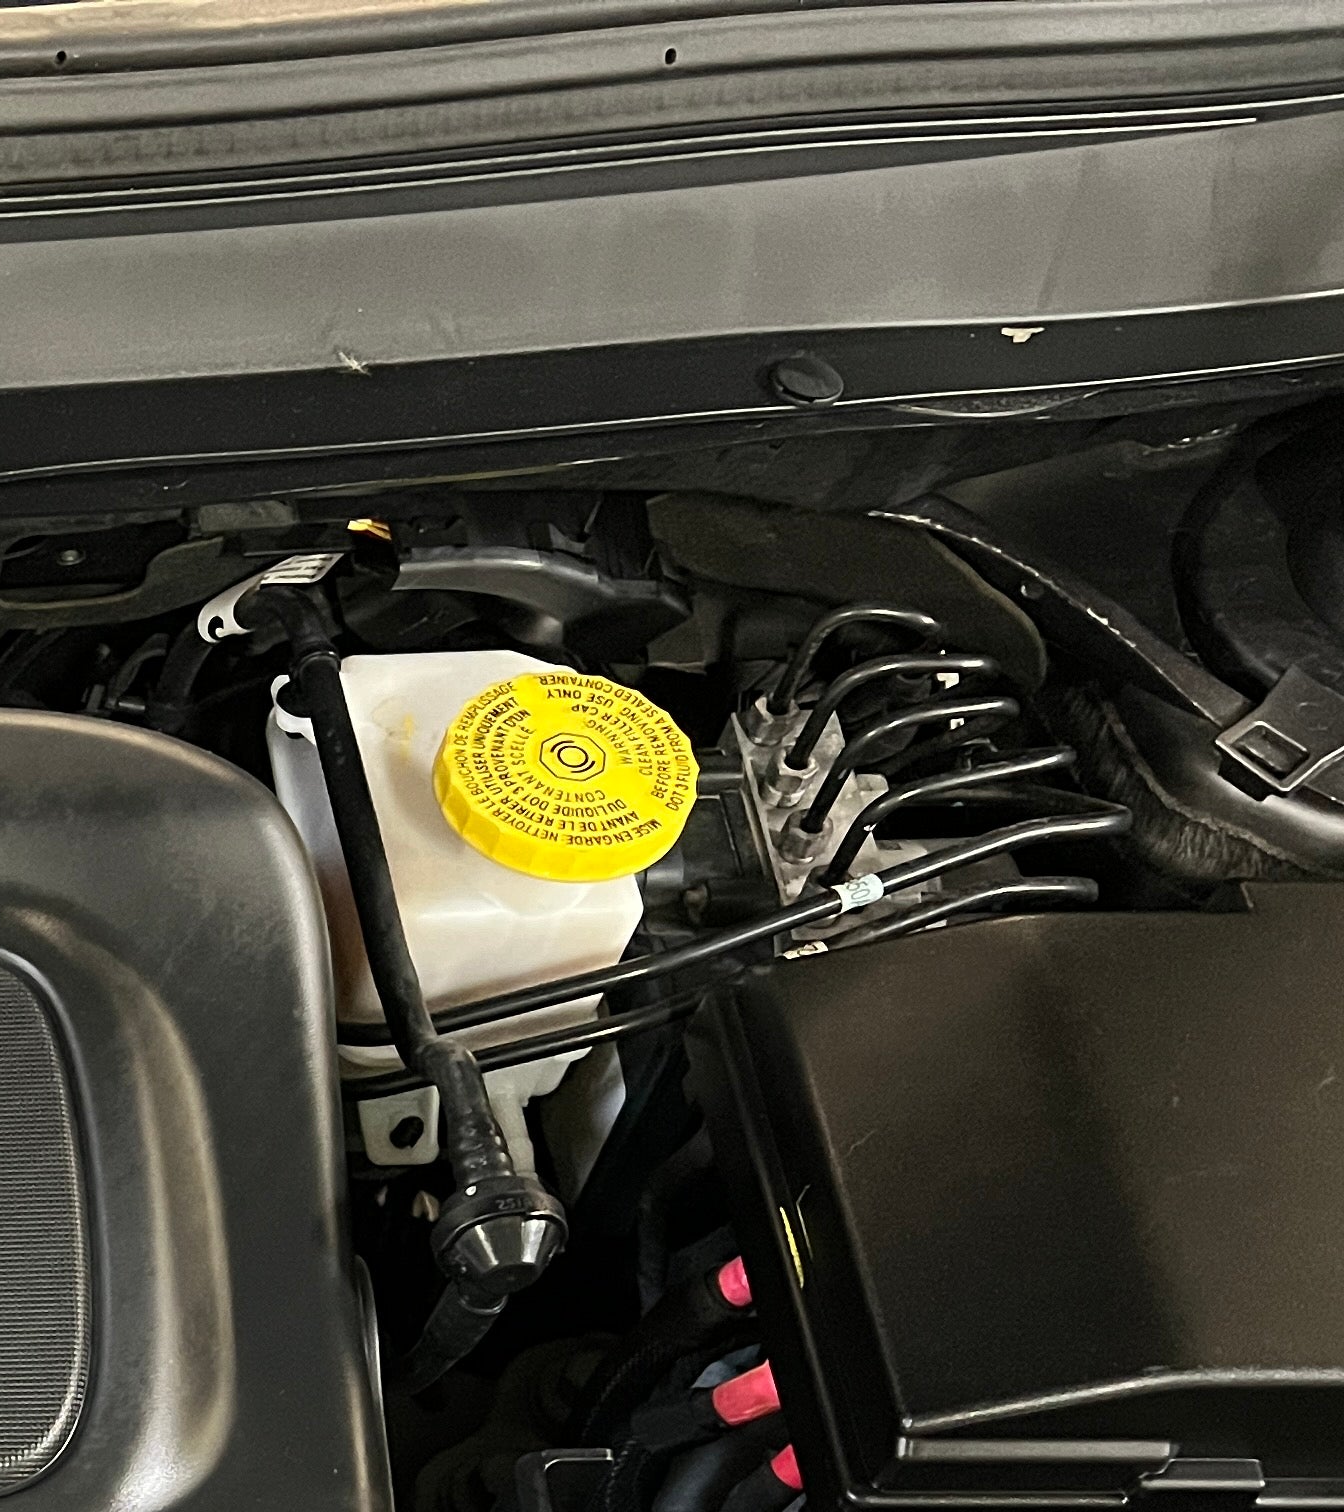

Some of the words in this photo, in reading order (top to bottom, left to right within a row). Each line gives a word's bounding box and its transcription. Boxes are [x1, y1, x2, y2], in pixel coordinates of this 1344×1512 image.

[547, 689, 582, 699] ONLY
[586, 693, 614, 708] USE
[614, 689, 658, 718] SEALED
[457, 681, 517, 732] REMPLISSAGE
[571, 704, 598, 716] CAP
[472, 697, 519, 750] UNIQUEMENT
[601, 713, 640, 741] FILLER
[655, 717, 666, 725] A
[453, 733, 468, 746] DE
[660, 725, 686, 752] FROM
[490, 726, 517, 787] PROVENANT
[634, 743, 653, 776] CLEAN
[454, 749, 485, 796] BOUCHON
[472, 752, 503, 795] UTILISER
[651, 760, 671, 799] BEFORE
[512, 786, 524, 794] 3
[517, 771, 606, 803] CONTENANT
[477, 796, 496, 810] LE
[500, 796, 554, 826] RETIRER
[521, 793, 550, 811] DOT
[552, 804, 608, 817] LIQUIDE
[607, 799, 627, 813] DU
[665, 791, 685, 811] DOT
[492, 808, 558, 841] NETTOYER
[558, 820, 575, 831] LE
[579, 821, 597, 832] DE
[600, 811, 639, 831] AVANT
[631, 819, 662, 838] MISE
[613, 831, 634, 843] EN
